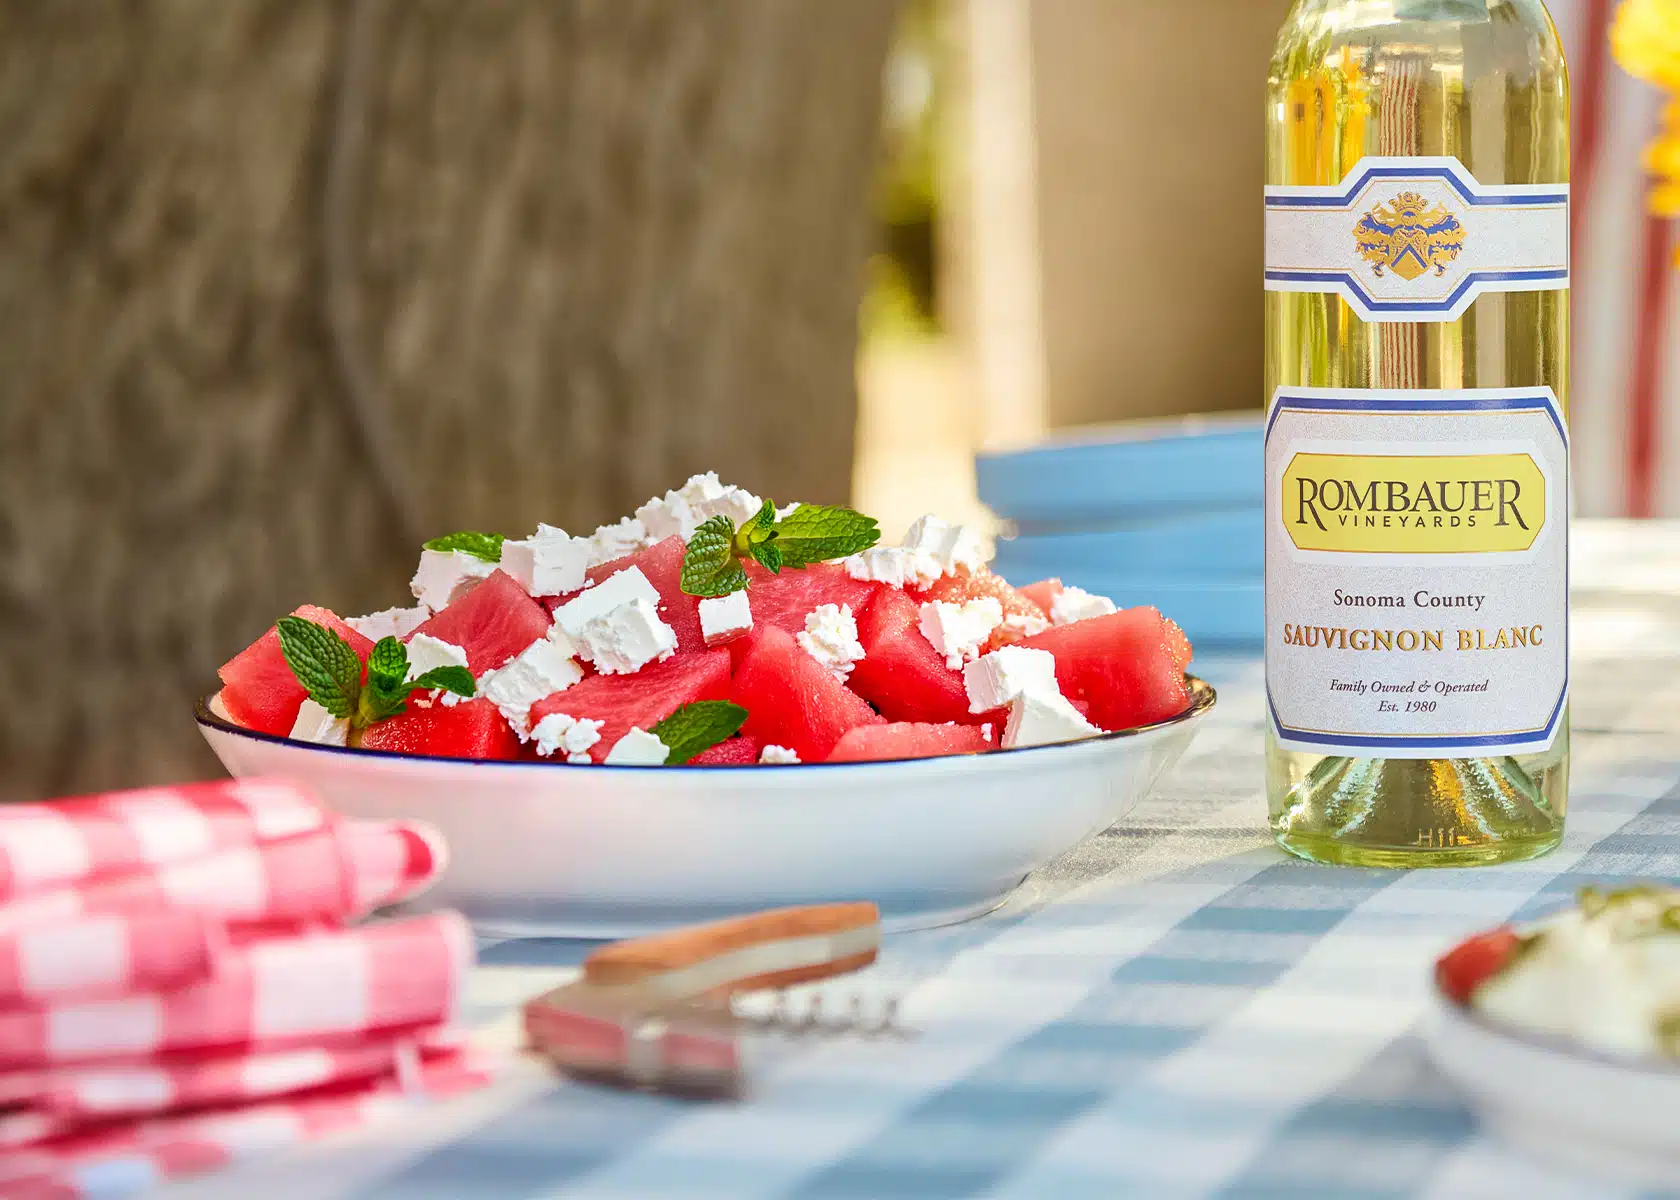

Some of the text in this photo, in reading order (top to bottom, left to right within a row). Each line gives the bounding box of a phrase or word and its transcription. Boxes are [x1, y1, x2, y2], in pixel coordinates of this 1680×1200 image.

[1296, 477, 1530, 532] ROMBAUER
[1338, 514, 1477, 528] VINEYARDS
[1333, 588, 1486, 611] Sonoma County
[1283, 622, 1543, 651] SAUVIGNON BLANC
[1329, 679, 1490, 696] Family Owned & Operated
[1378, 701, 1437, 713] Est. 1980
